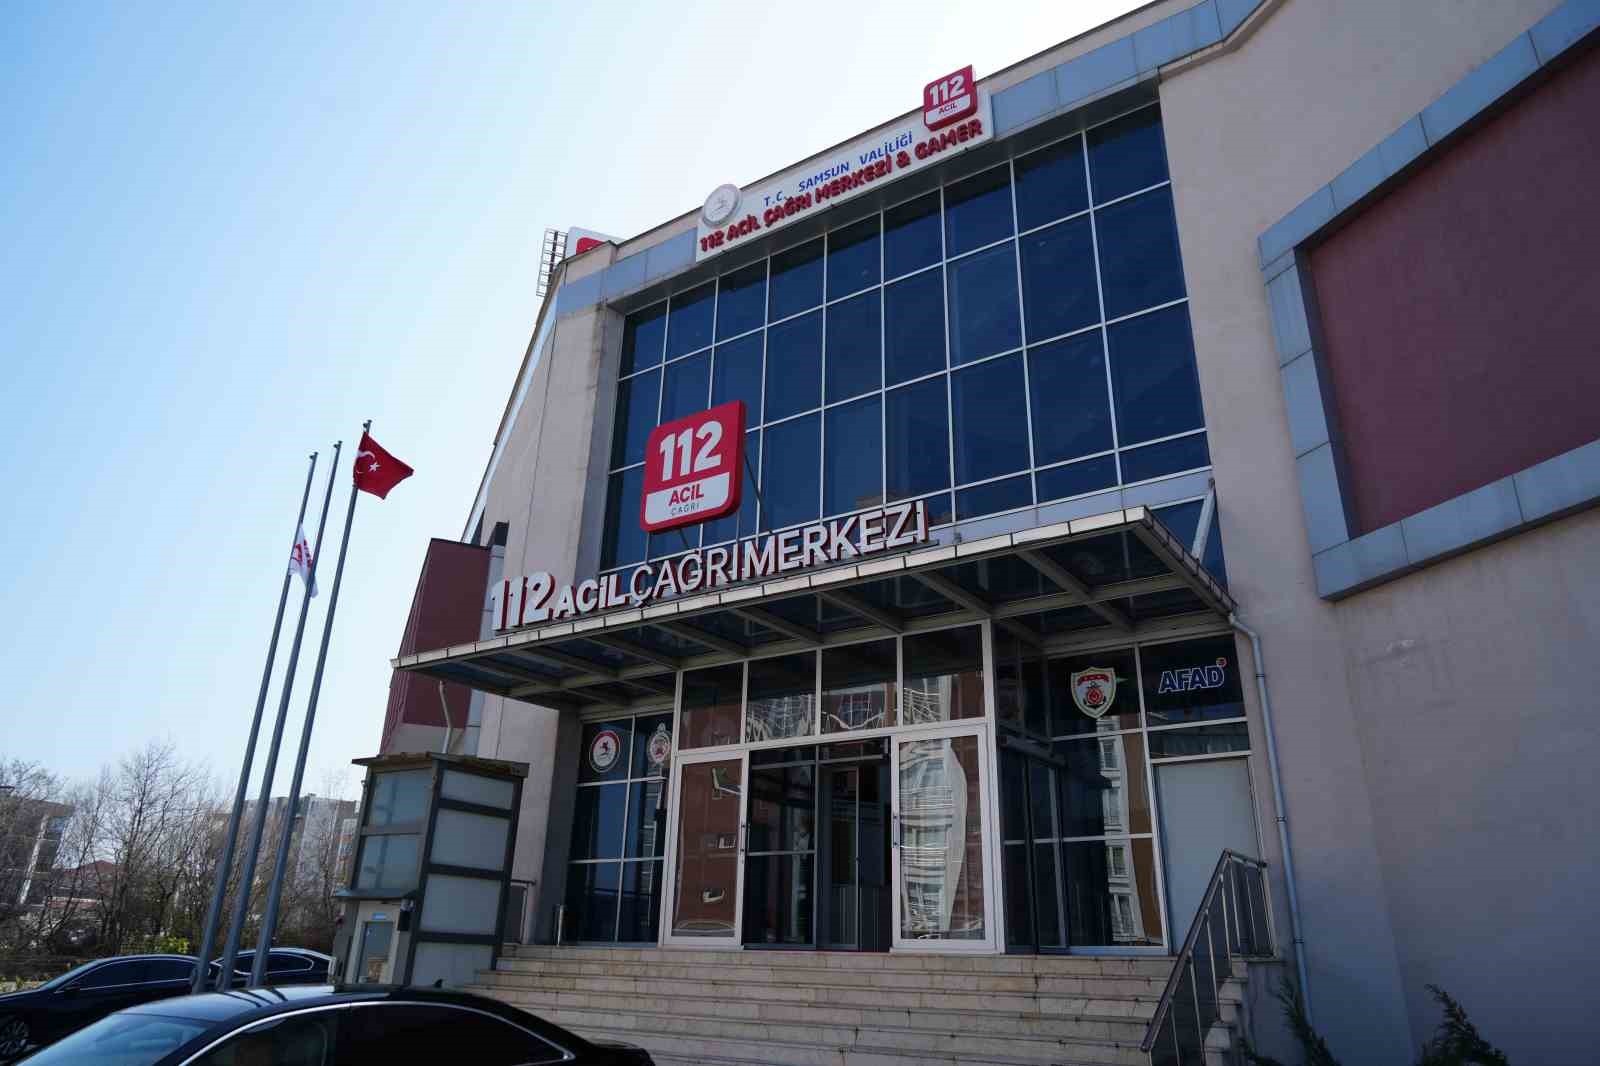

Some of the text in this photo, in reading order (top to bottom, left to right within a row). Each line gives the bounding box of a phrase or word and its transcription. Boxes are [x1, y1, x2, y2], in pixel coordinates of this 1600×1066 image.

[929, 75, 965, 106] 112
[798, 161, 849, 192] SAMSUN
[859, 130, 913, 165] VALİLİĞİ
[700, 230, 725, 252] 112
[727, 214, 761, 241] ACİL
[763, 191, 812, 228] ÇAĞRI
[815, 152, 893, 204] MERKEZİ
[895, 150, 911, 169] &
[659, 420, 722, 481] 112
[489, 571, 556, 630] 112
[1158, 665, 1225, 694] AFAD
